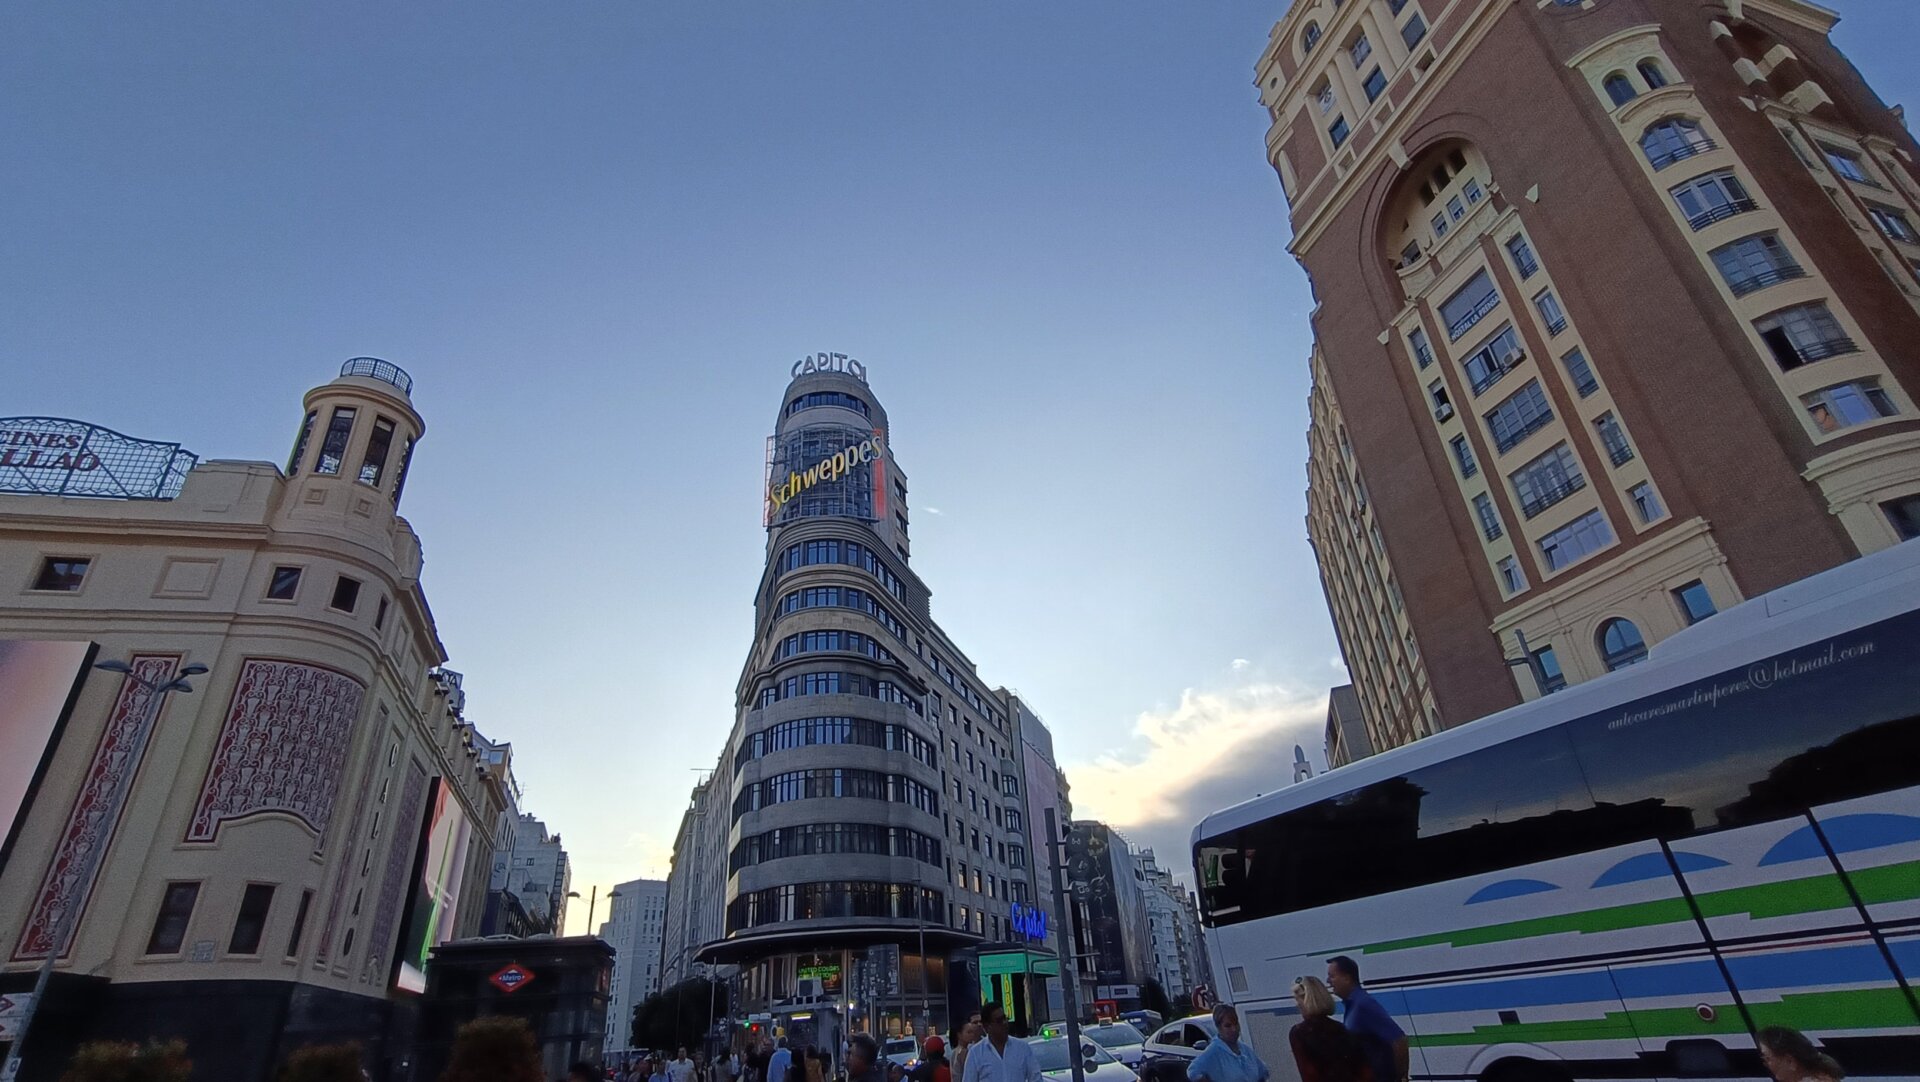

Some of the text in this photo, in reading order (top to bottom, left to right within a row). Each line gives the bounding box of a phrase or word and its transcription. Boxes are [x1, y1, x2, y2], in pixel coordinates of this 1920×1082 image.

[1451, 295, 1499, 341] HOSTAL LA PRENSA
[768, 436, 882, 518] Schweppes
[1607, 641, 1875, 731] autocaresmartinperez@hotmail.com
[343, 742, 399, 957] CALLAO
